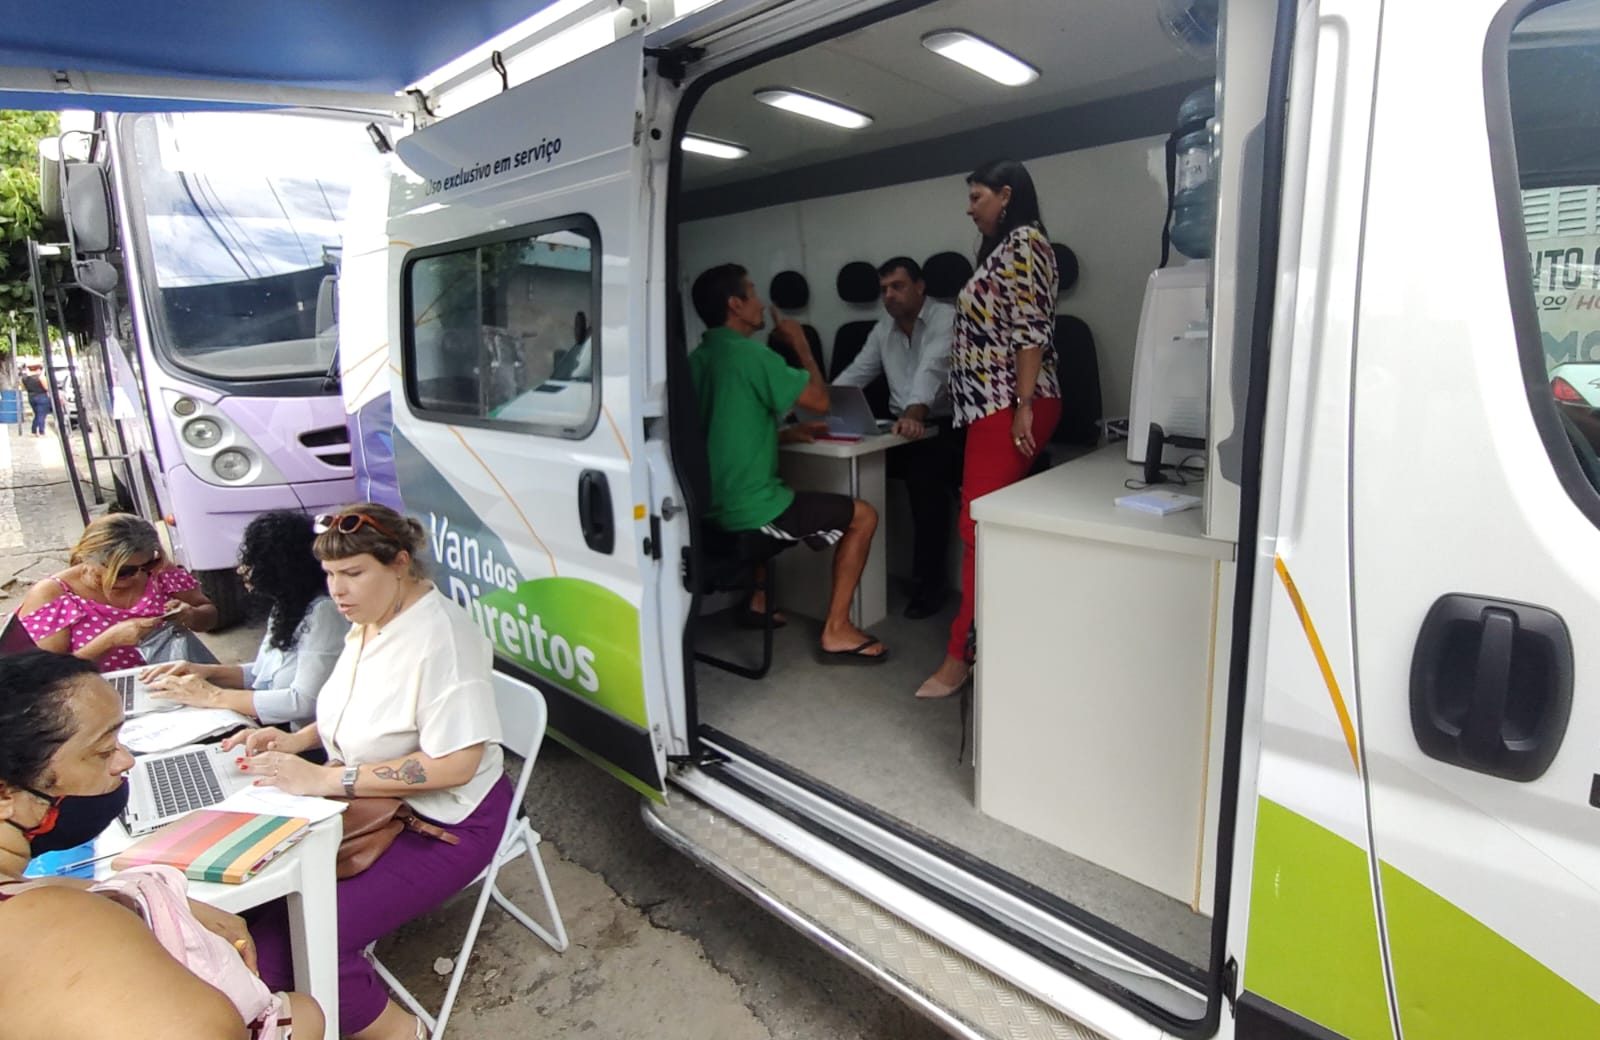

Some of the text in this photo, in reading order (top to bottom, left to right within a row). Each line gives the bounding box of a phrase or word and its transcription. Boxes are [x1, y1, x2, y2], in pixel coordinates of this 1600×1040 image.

[425, 137, 562, 196] Uso exclusivo em serviço
[430, 511, 518, 594] Van dos
[449, 575, 600, 693] Direitos
